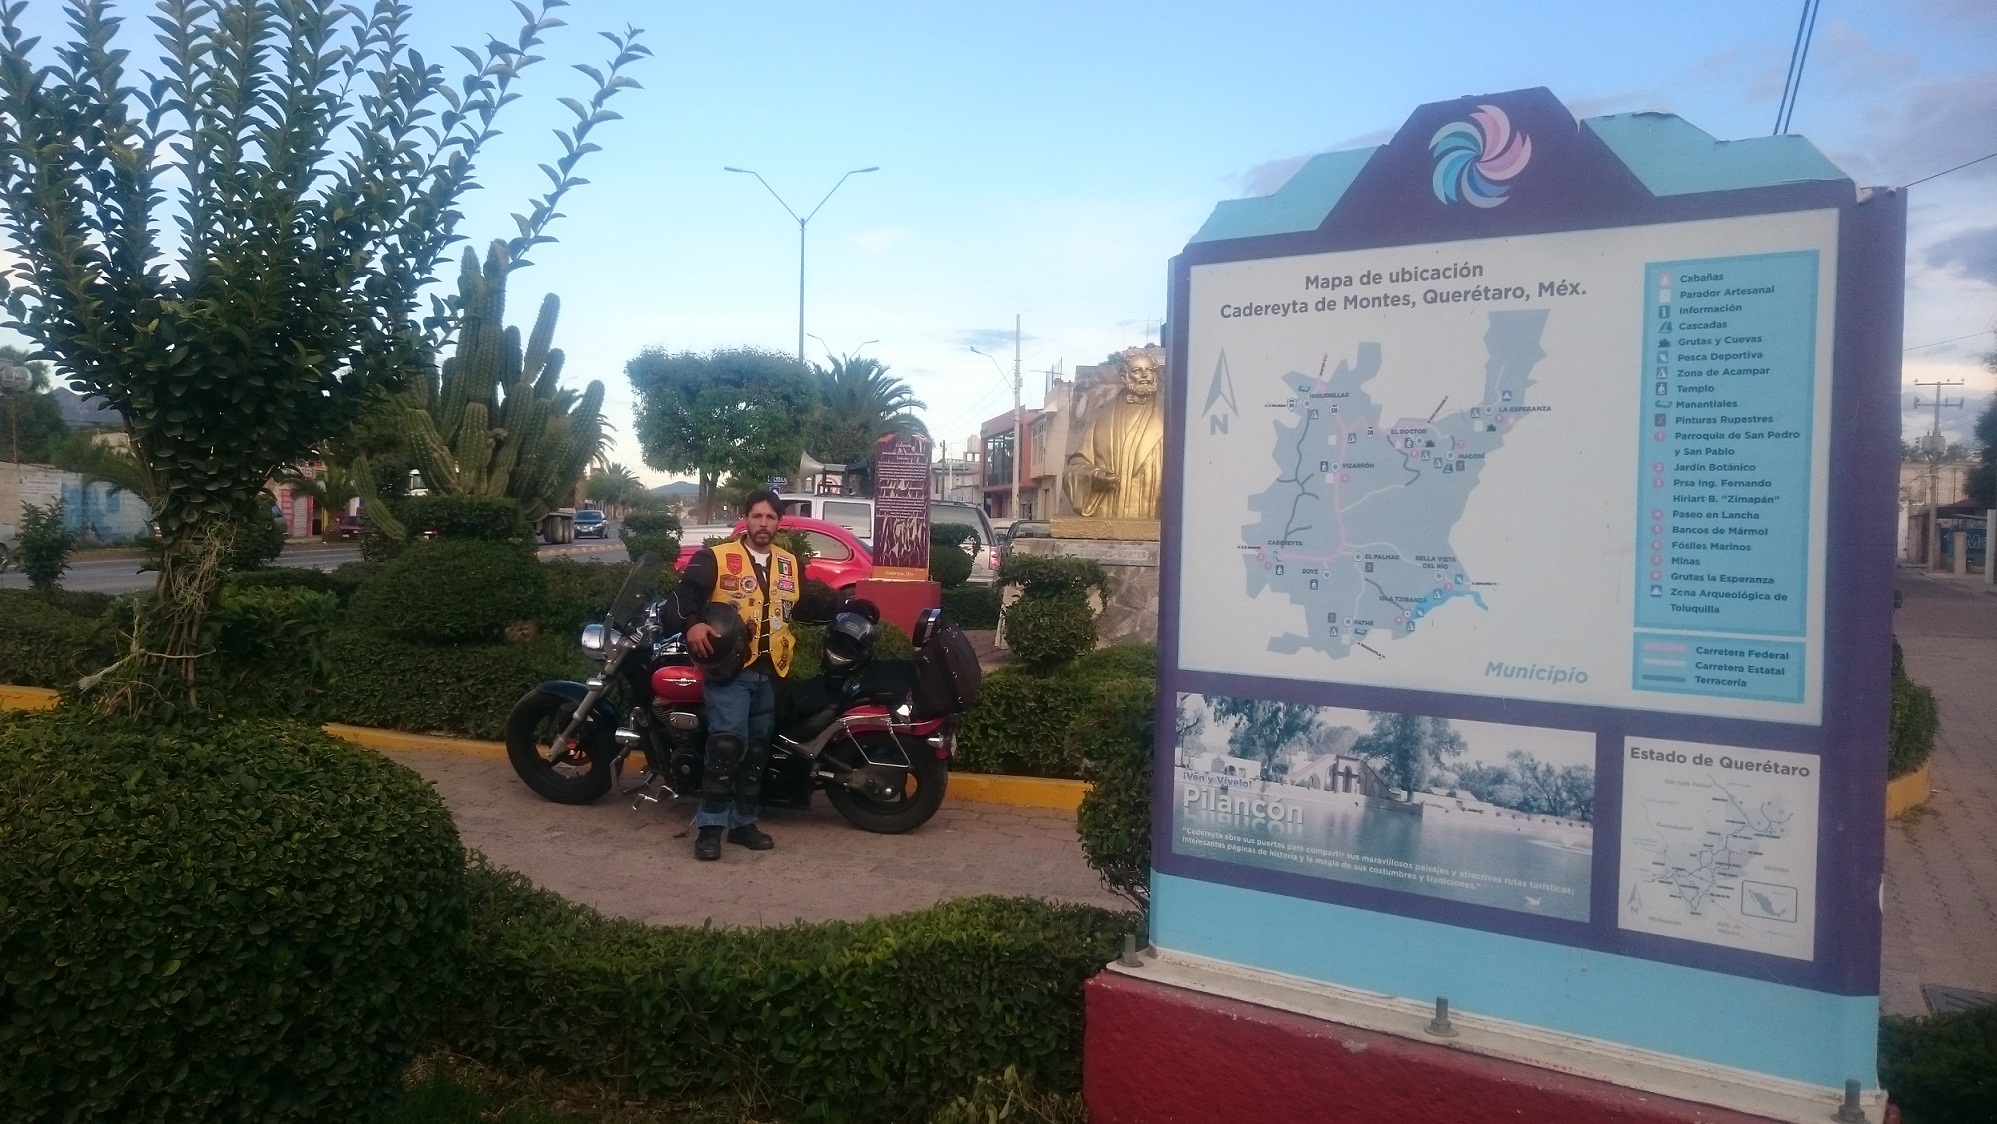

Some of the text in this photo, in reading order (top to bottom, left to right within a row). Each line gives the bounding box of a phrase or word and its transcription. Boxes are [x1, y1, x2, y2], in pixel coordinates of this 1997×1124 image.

[1305, 262, 1483, 291] Mapa de ubicación
[1680, 273, 1724, 283] Cabañas
[1680, 285, 1775, 298] Parador Artesanal
[1220, 279, 1587, 320] Cadereyta de Montes, Querétaro, Méx.
[1680, 304, 1742, 315] Información
[1679, 321, 1727, 330] Cascadas
[1678, 338, 1712, 346] Grutas
[1725, 336, 1762, 344] Cuevas
[1678, 351, 1763, 362] Pesca Deportiva
[1723, 367, 1770, 376] Acampar
[1677, 384, 1714, 394] Templo
[1676, 400, 1738, 408] Manantiales
[1210, 413, 1228, 435] N
[1676, 415, 1773, 424] Pinturas Rupestres
[1675, 432, 1725, 441] Parroquia
[1728, 432, 1741, 440] de
[1744, 431, 1764, 439] San
[1768, 430, 1800, 439] Pedro
[1705, 447, 1735, 455] Pablo
[1674, 463, 1706, 472] Jardín
[1709, 463, 1756, 472] Botánico
[1698, 480, 1717, 488] Ing.
[1722, 511, 1759, 520] Lancha
[1728, 525, 1768, 536] Mármol
[1672, 541, 1708, 550] Fósiles
[1710, 542, 1751, 551] Marinos
[1671, 557, 1700, 565] Minas
[1671, 573, 1704, 582] Grutas
[1707, 574, 1716, 582] la
[1720, 574, 1775, 585] Esperanza
[1670, 589, 1788, 601] Zona Arqueológica de
[1670, 604, 1720, 614] Toluquilla
[1696, 646, 1789, 660] Carretera Federal
[1485, 661, 1588, 684] Municipio
[1695, 662, 1784, 676] Carretera Estatal
[1695, 675, 1747, 687] Terracería
[1630, 747, 1810, 777] Estado de Querétaro
[1184, 785, 1302, 824] Pilancón
[1227, 844, 1255, 854] páginas
[1269, 850, 1297, 860] historia
[1315, 858, 1339, 867] magia
[1369, 866, 1416, 880] costumbres
[1257, 839, 1285, 848] puertas
[1287, 843, 1304, 851] para
[1306, 847, 1344, 857] compartir
[1362, 855, 1412, 869] maravillosos
[1414, 864, 1449, 875] paisajes
[1459, 871, 1501, 883] atractivas
[1505, 878, 1526, 887] rutas
